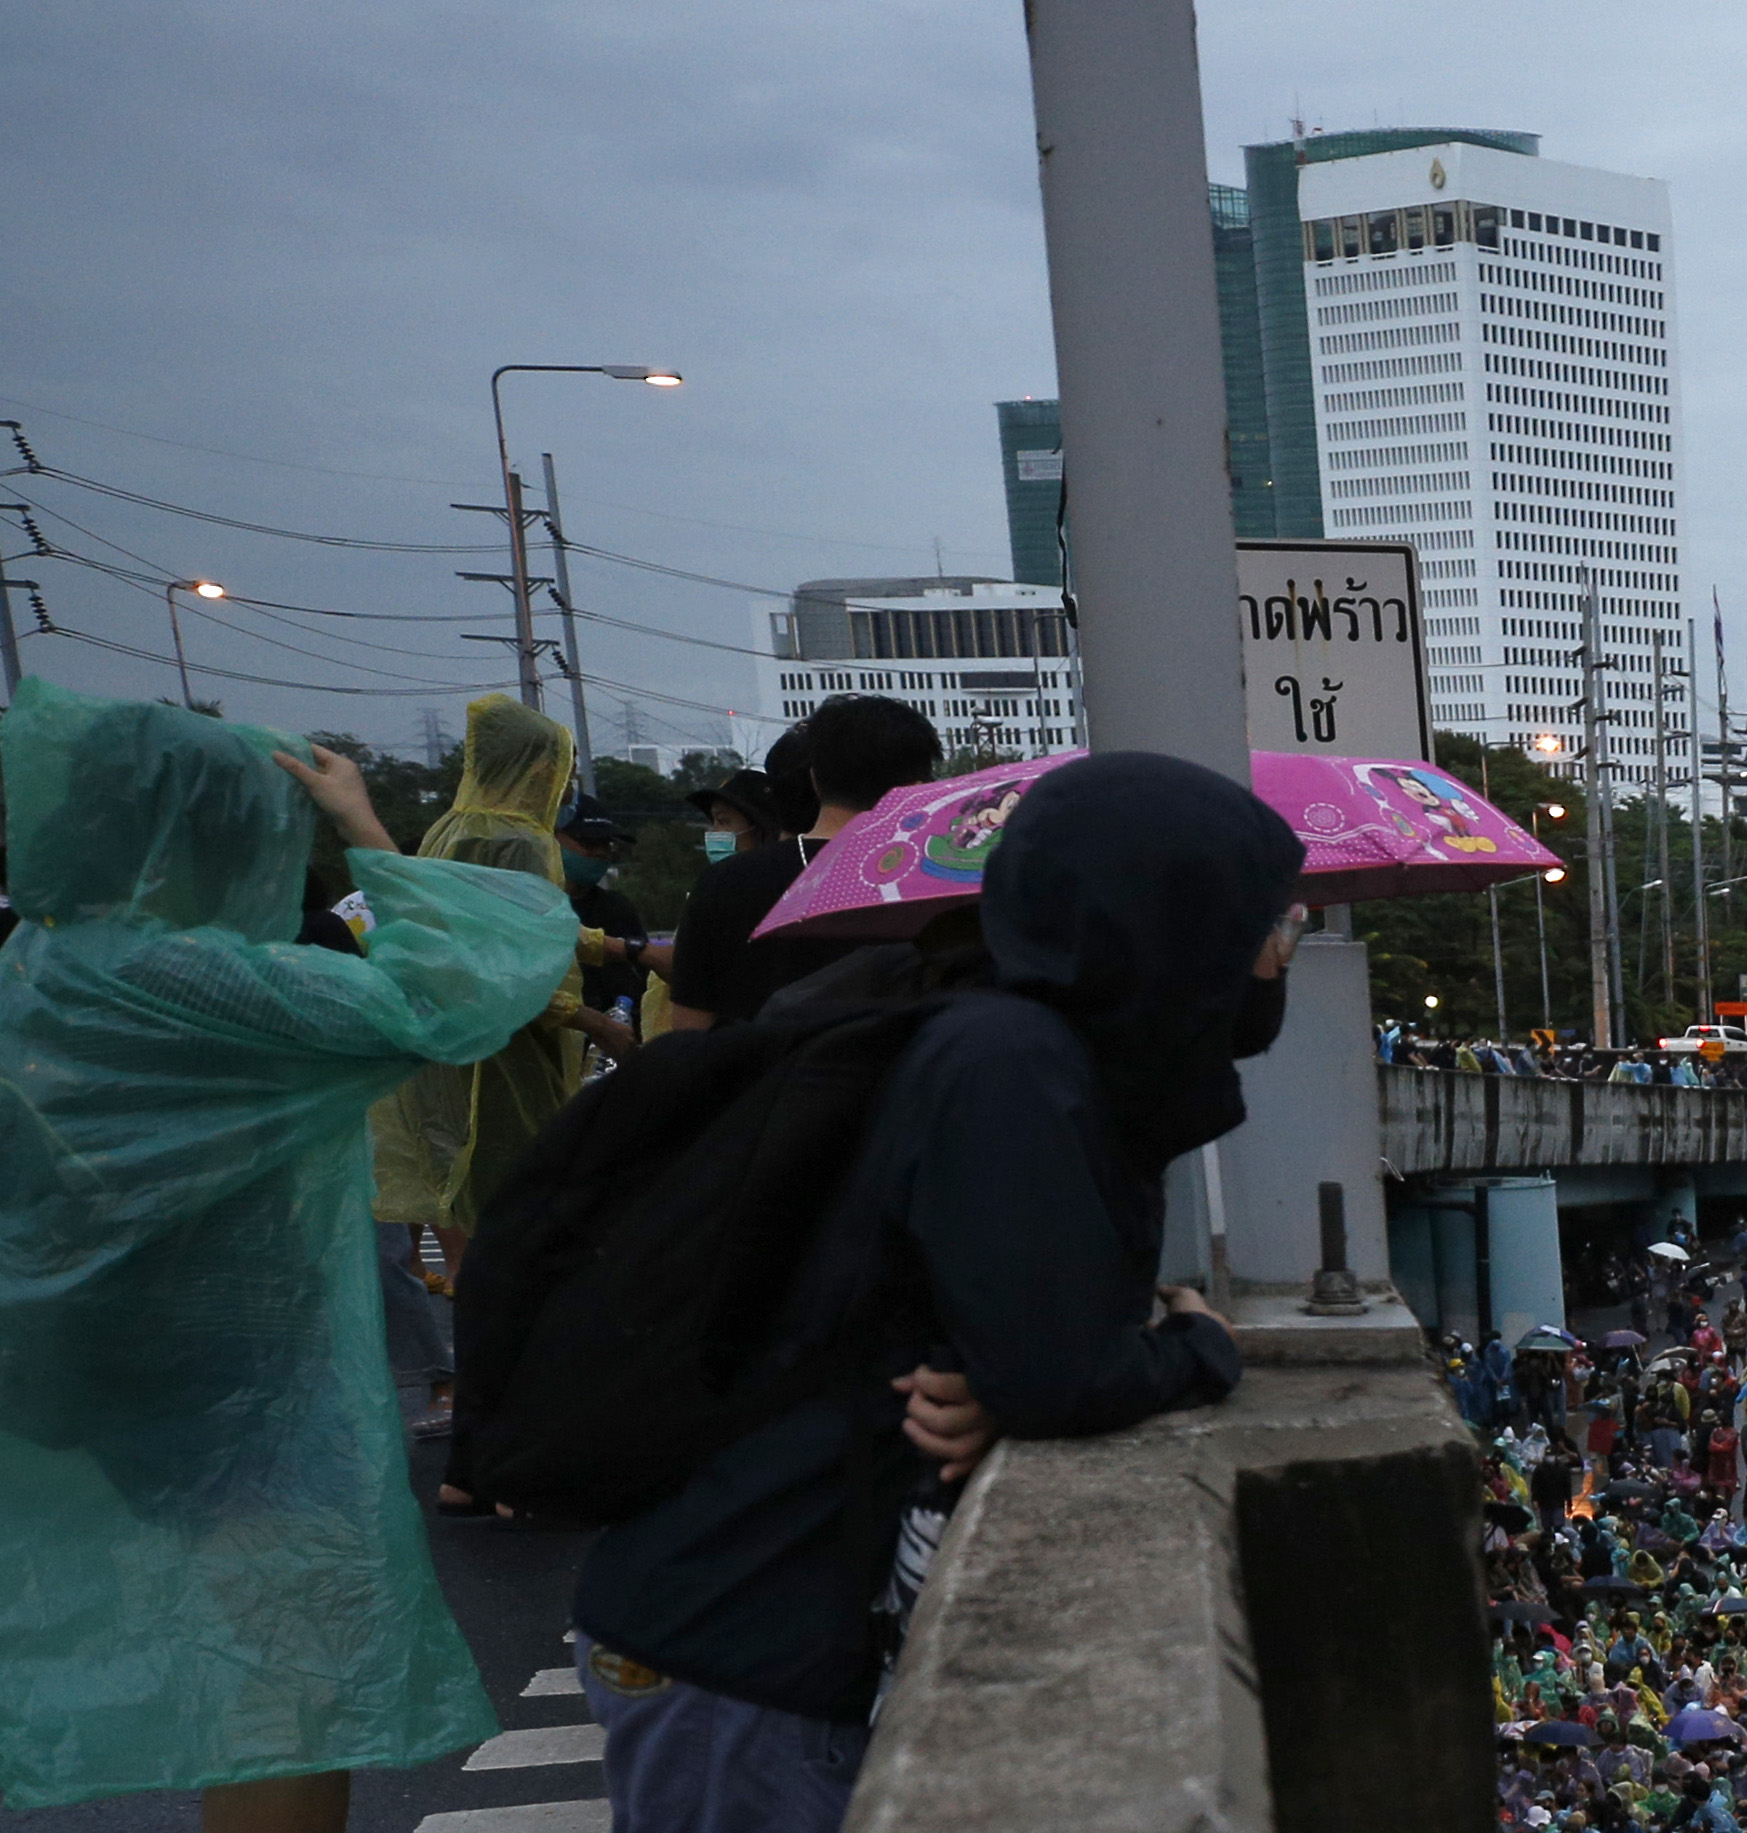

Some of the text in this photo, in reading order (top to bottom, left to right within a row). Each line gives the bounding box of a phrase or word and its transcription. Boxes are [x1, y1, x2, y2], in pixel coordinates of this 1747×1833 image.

[1239, 577, 1408, 642] าดพร้าว
[1274, 675, 1344, 743] ใช้
